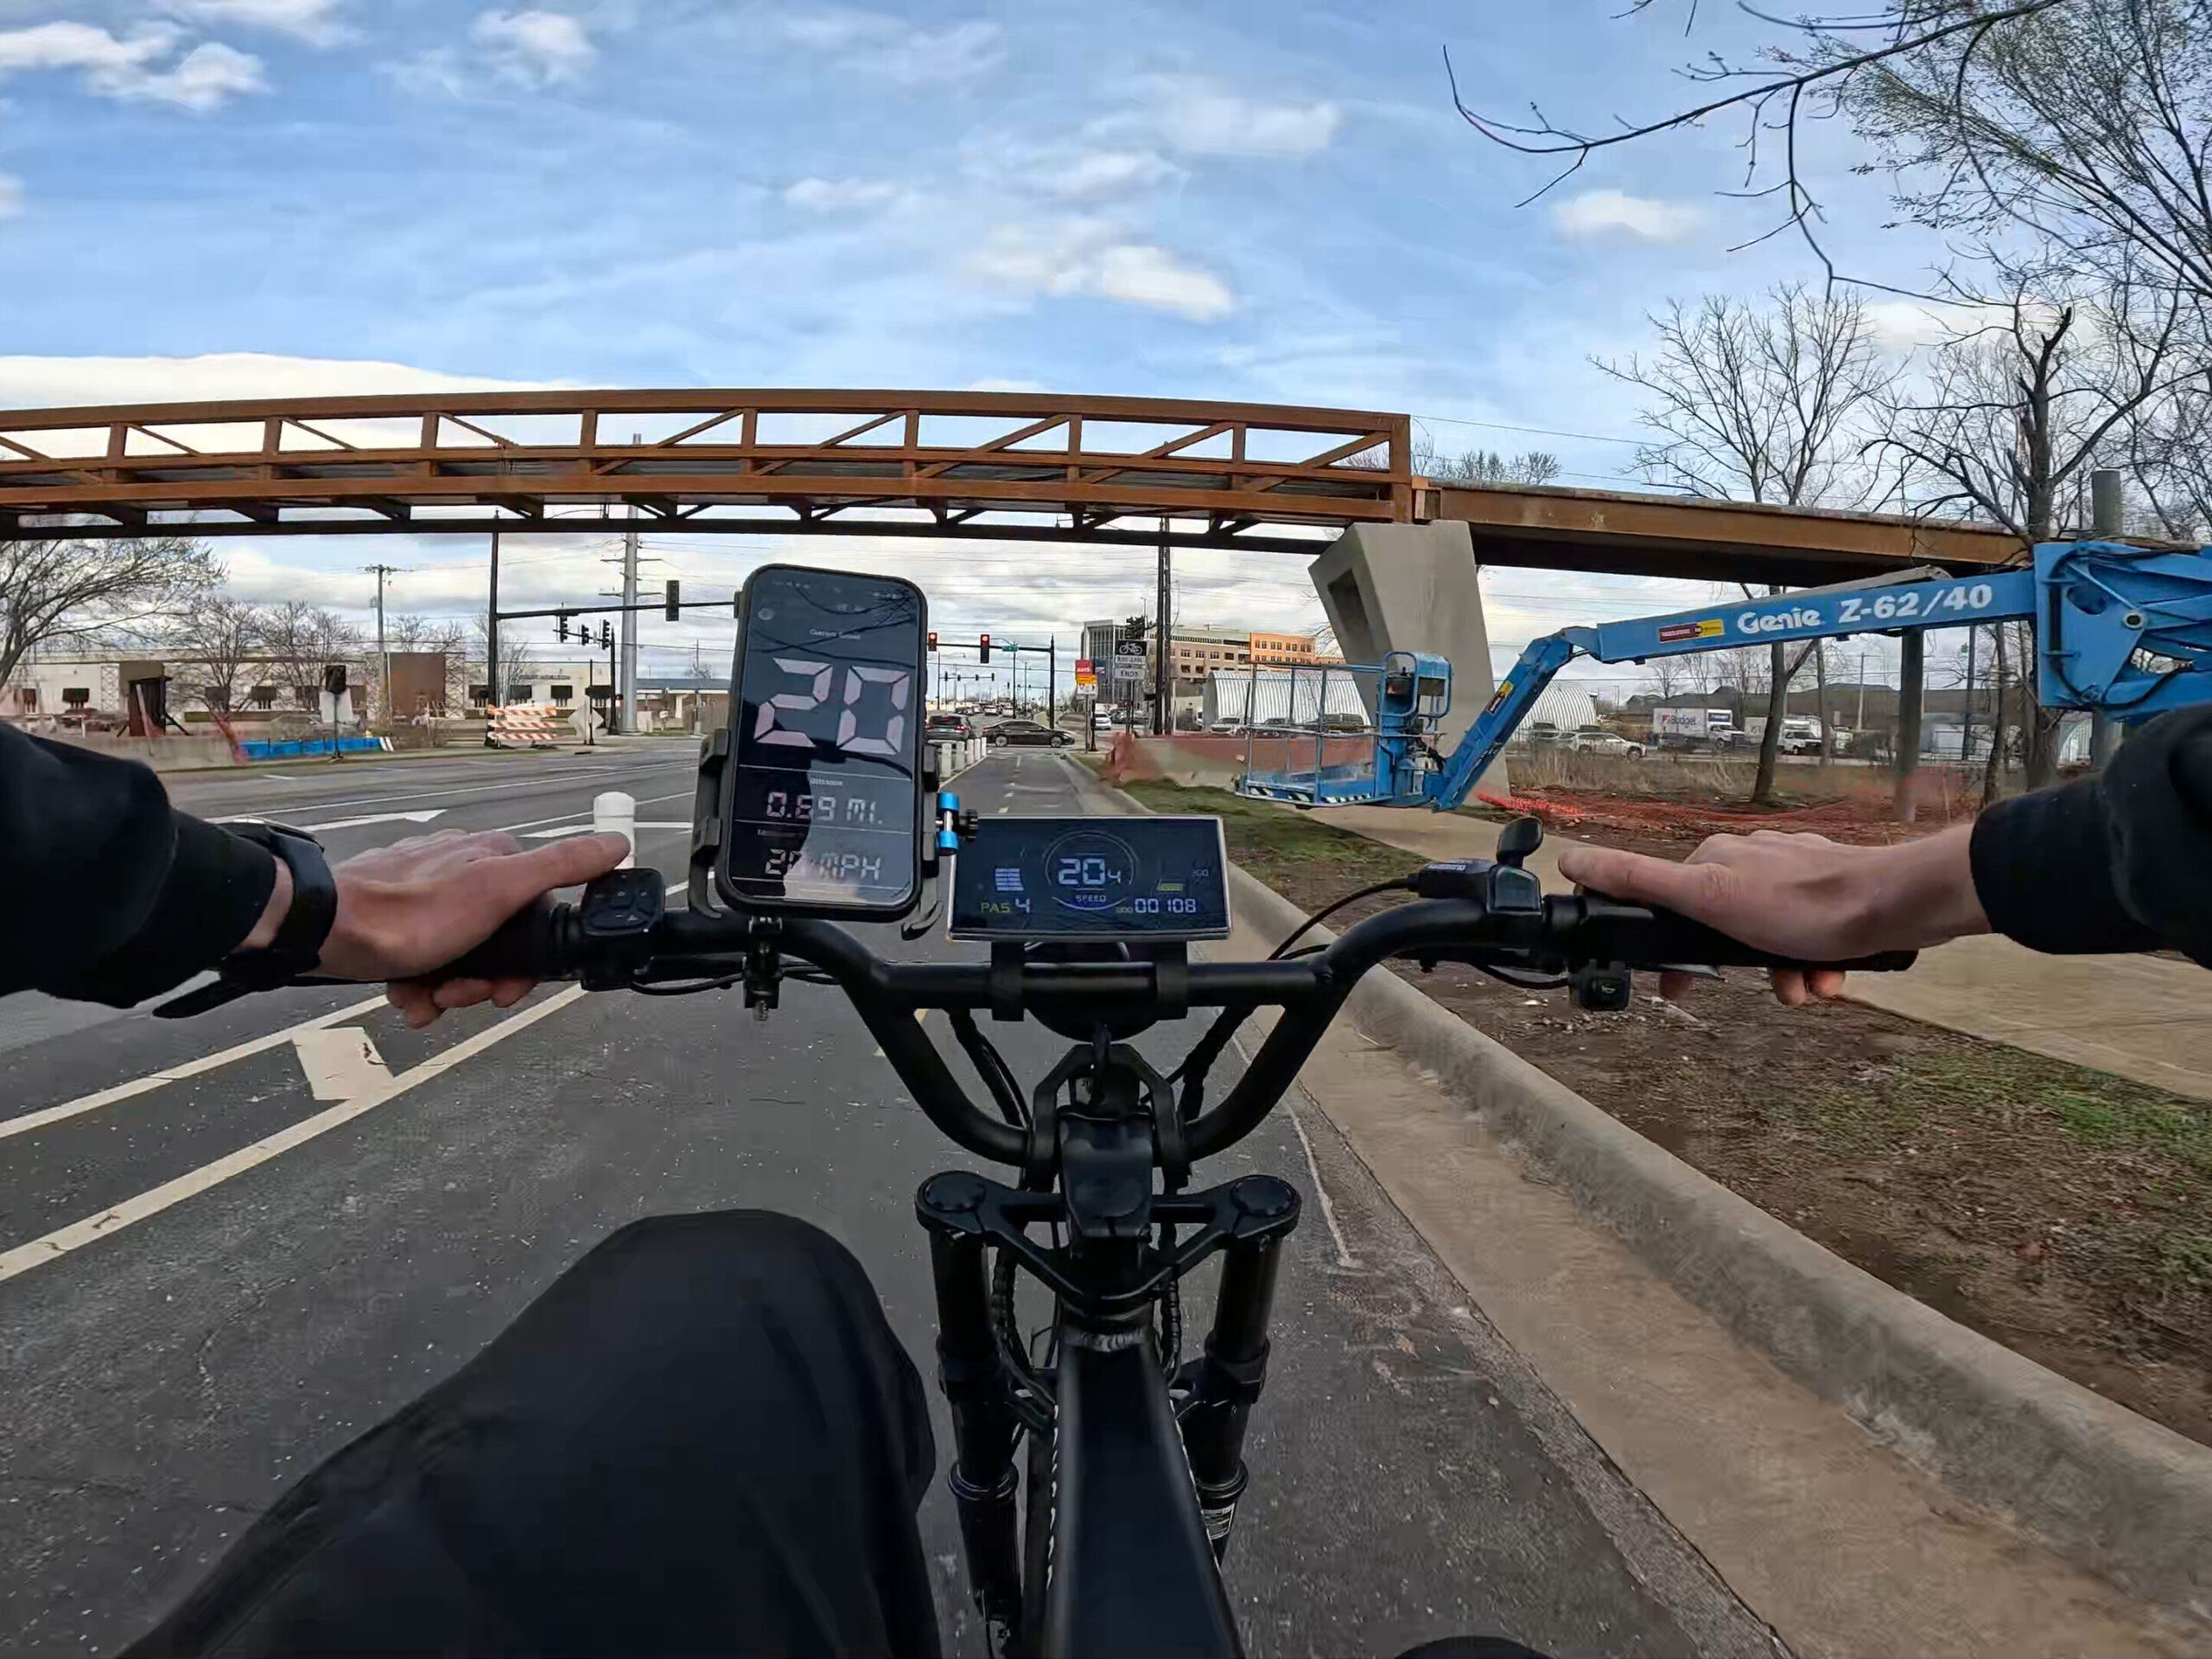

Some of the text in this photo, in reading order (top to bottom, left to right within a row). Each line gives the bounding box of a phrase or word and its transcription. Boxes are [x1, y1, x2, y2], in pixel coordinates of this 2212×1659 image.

[1737, 583, 1993, 634] Genie Z-62/40
[754, 658, 910, 755] 20
